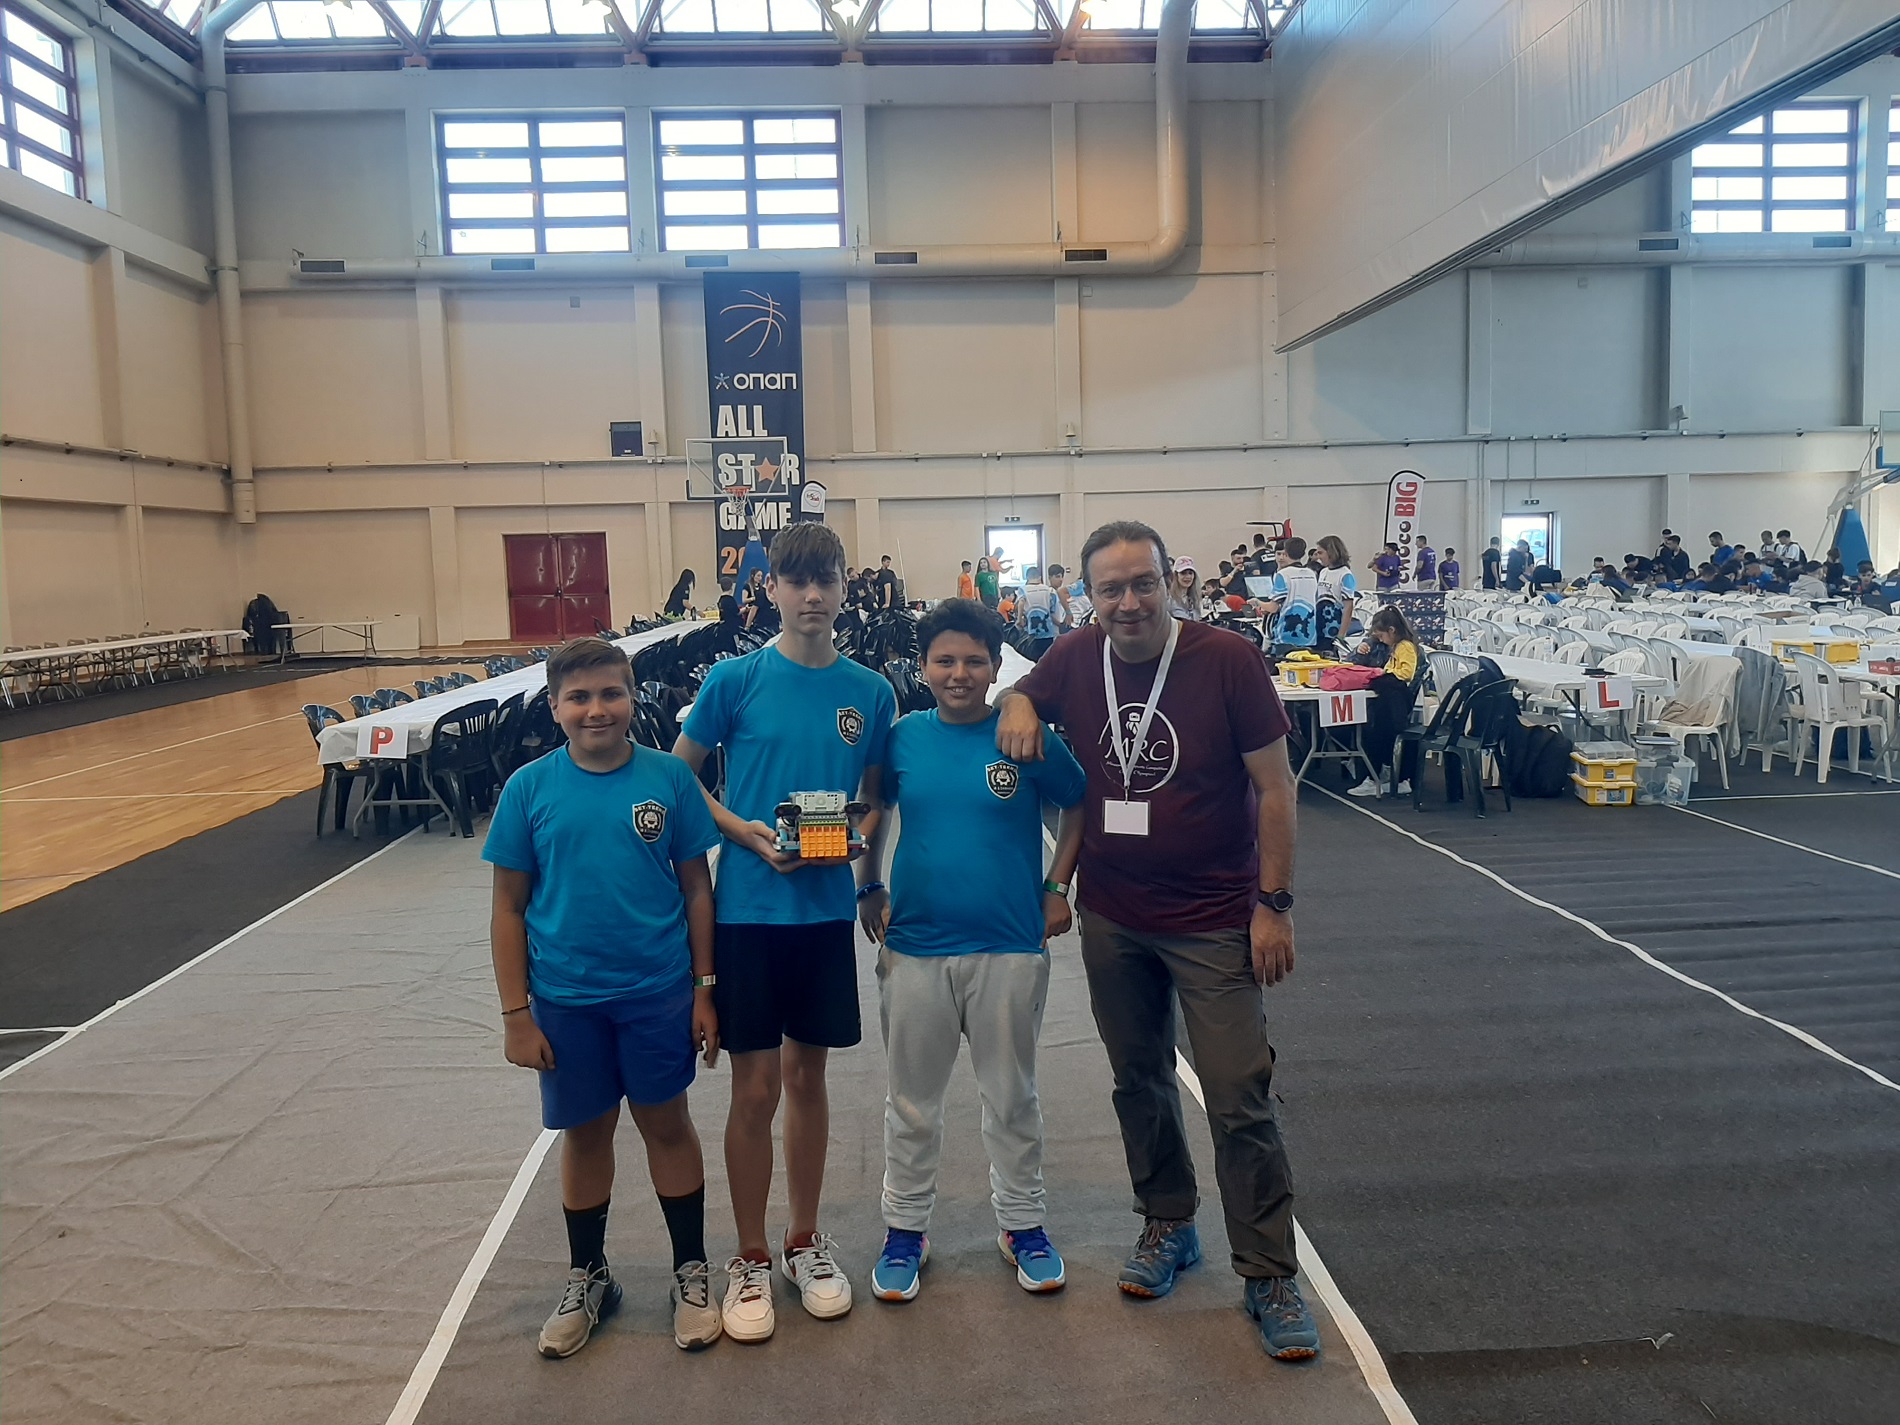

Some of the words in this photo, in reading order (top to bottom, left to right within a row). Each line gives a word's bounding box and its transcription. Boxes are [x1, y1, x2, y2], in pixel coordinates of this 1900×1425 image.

[716, 404, 768, 437] ALL
[1394, 482, 1418, 516] BIG
[1598, 681, 1620, 708] L
[1331, 695, 1353, 723] M
[370, 726, 394, 754] P
